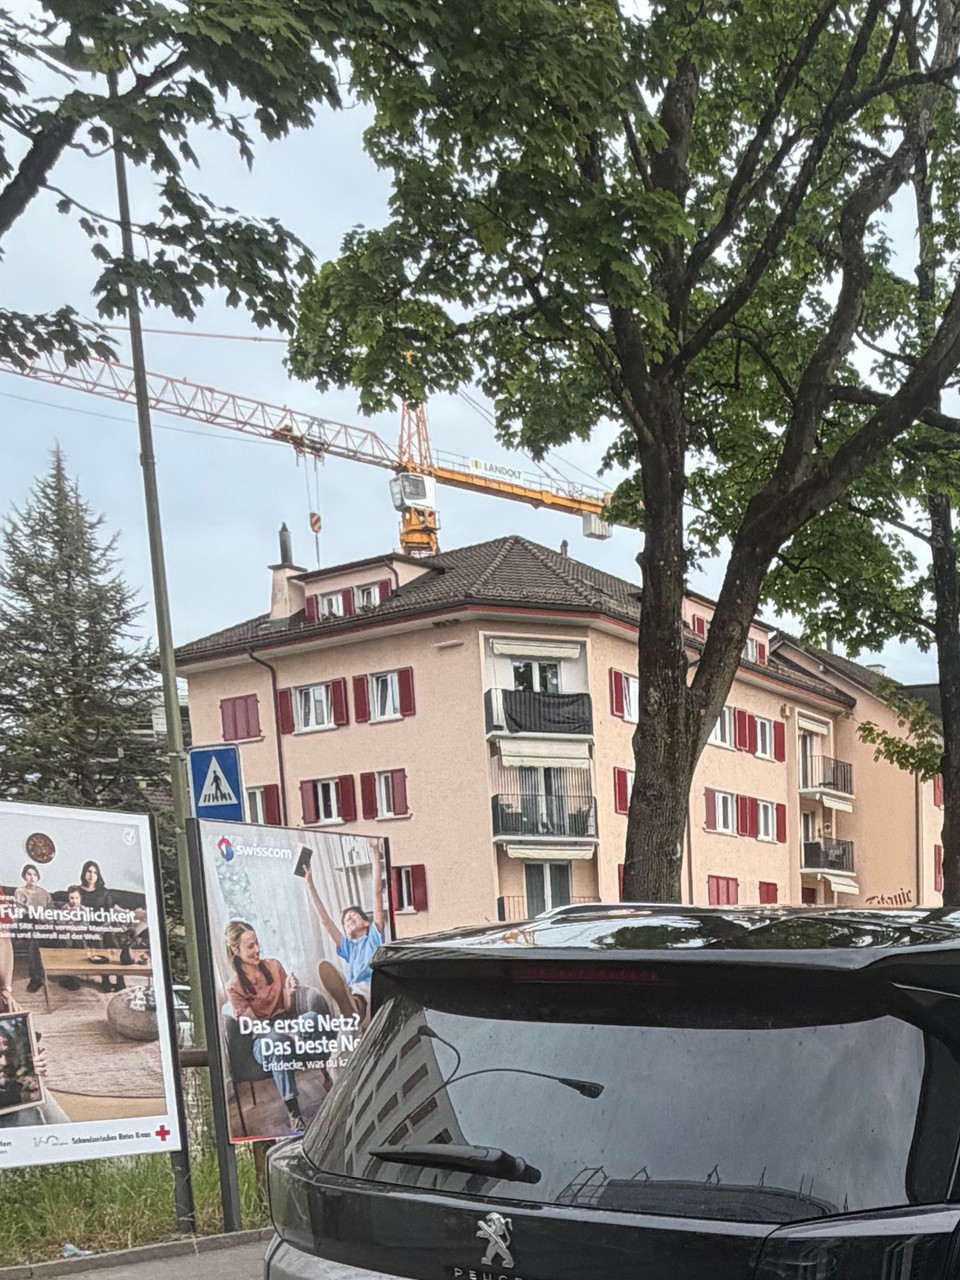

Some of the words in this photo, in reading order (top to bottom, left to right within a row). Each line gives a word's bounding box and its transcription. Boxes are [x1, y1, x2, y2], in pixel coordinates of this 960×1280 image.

[484, 461, 521, 479] LANDOLT
[236, 843, 292, 859] swisscom
[0, 903, 25, 919] Für
[28, 905, 140, 923] Menschlichkeit.
[239, 1016, 272, 1035] Das
[274, 1016, 315, 1034] erste
[317, 1013, 361, 1032] Netz?
[260, 1038, 292, 1056] Das
[294, 1036, 338, 1055] beste
[306, 1060, 325, 1070] was
[326, 1057, 338, 1068] du
